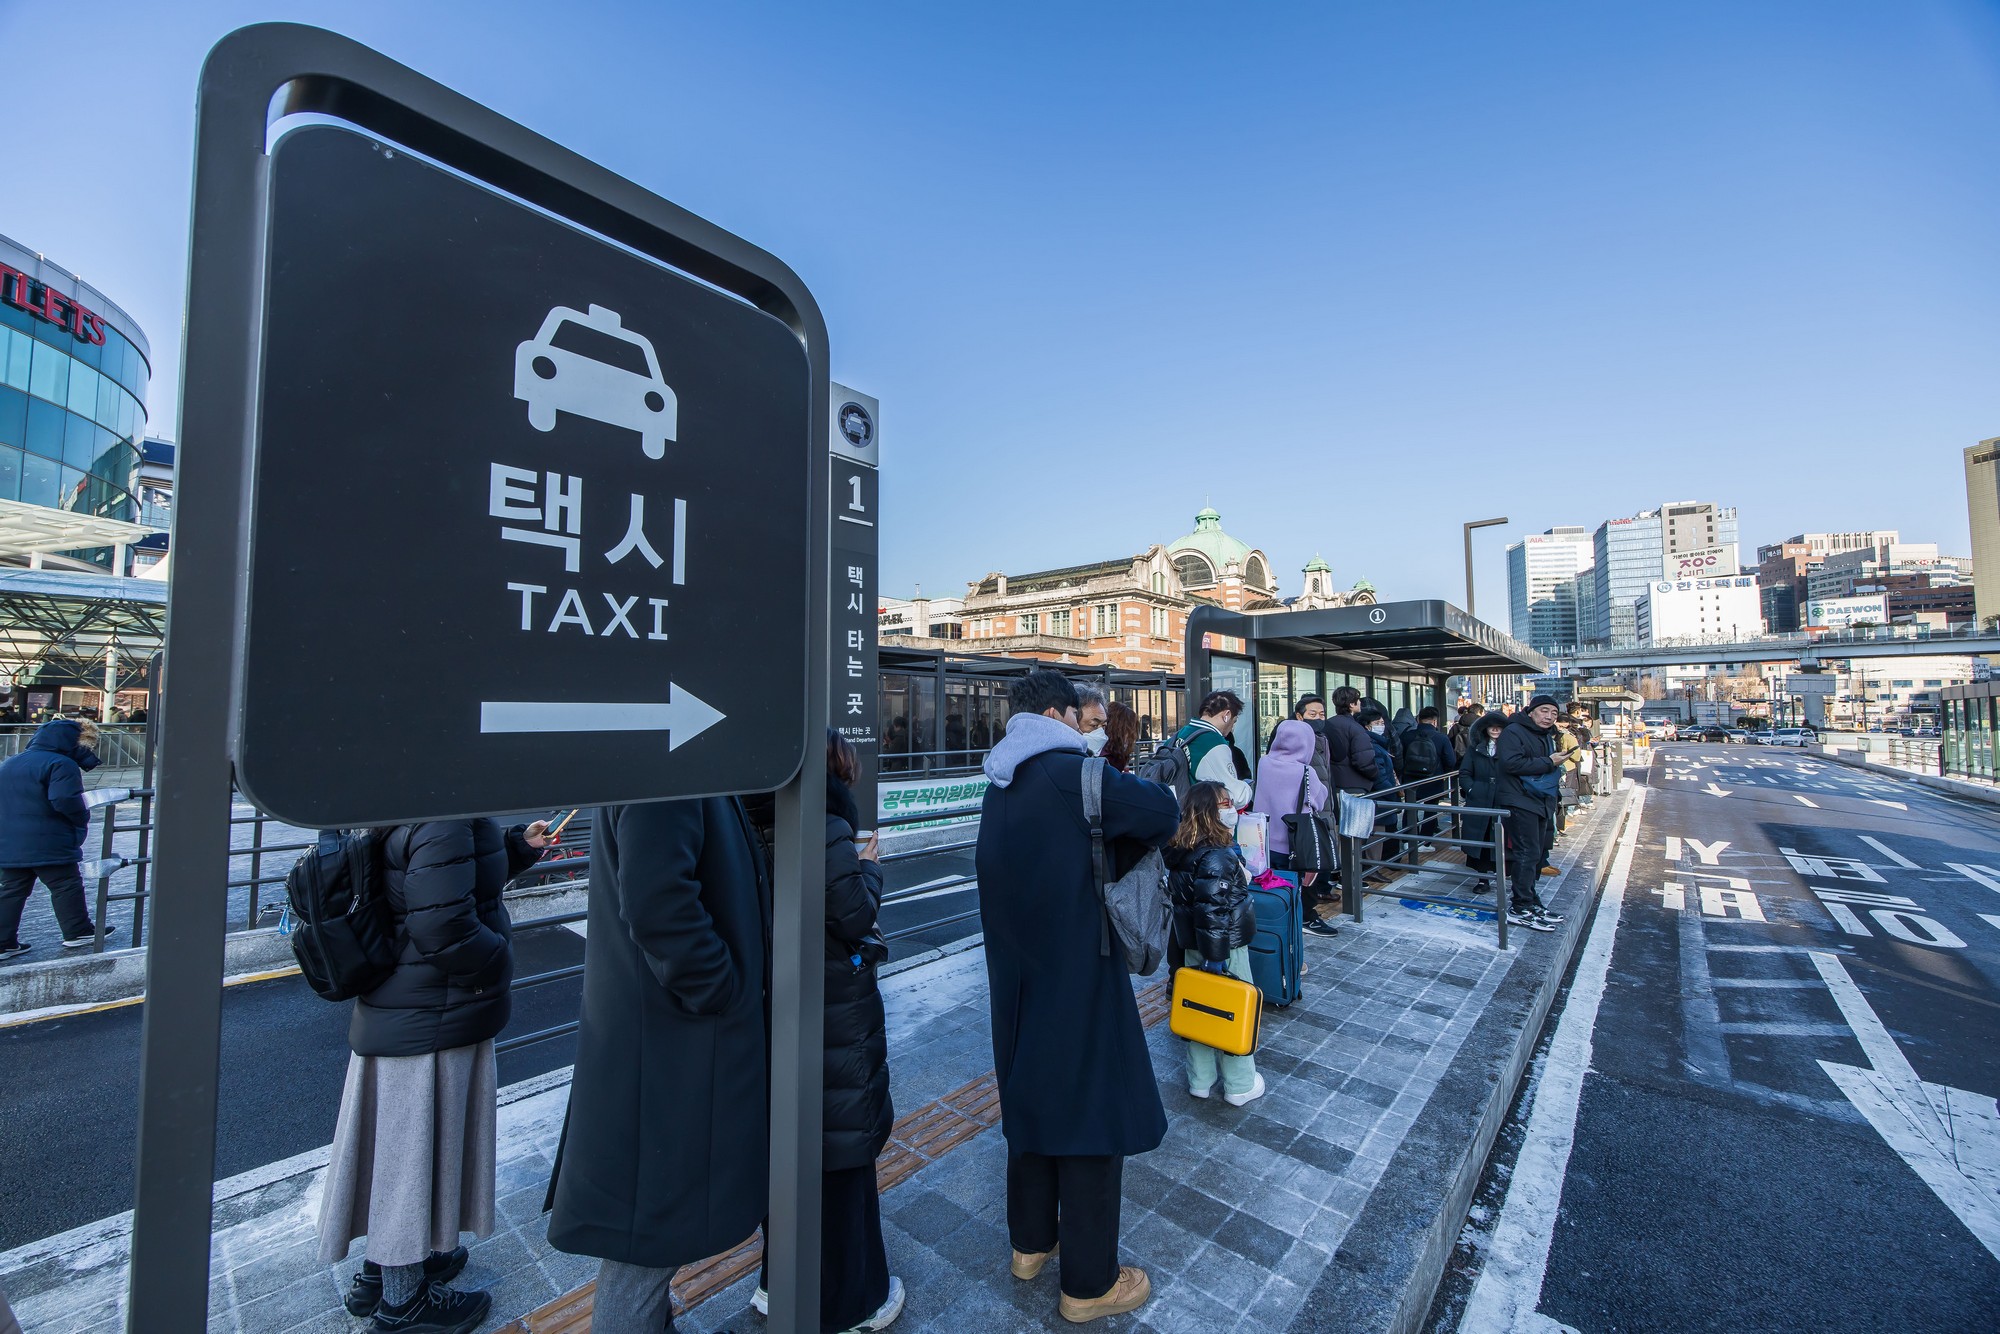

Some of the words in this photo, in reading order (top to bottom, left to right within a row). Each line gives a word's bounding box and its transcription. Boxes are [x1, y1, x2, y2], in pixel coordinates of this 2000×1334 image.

[848, 475, 866, 513] 1
[488, 462, 687, 586] 택시
[847, 566, 864, 615] 택시
[1676, 578, 1752, 591] 한진택배
[506, 582, 669, 640] TAXI
[1827, 604, 1882, 615] DAEWON
[847, 629, 864, 678] 타는
[847, 693, 863, 714] 곳
